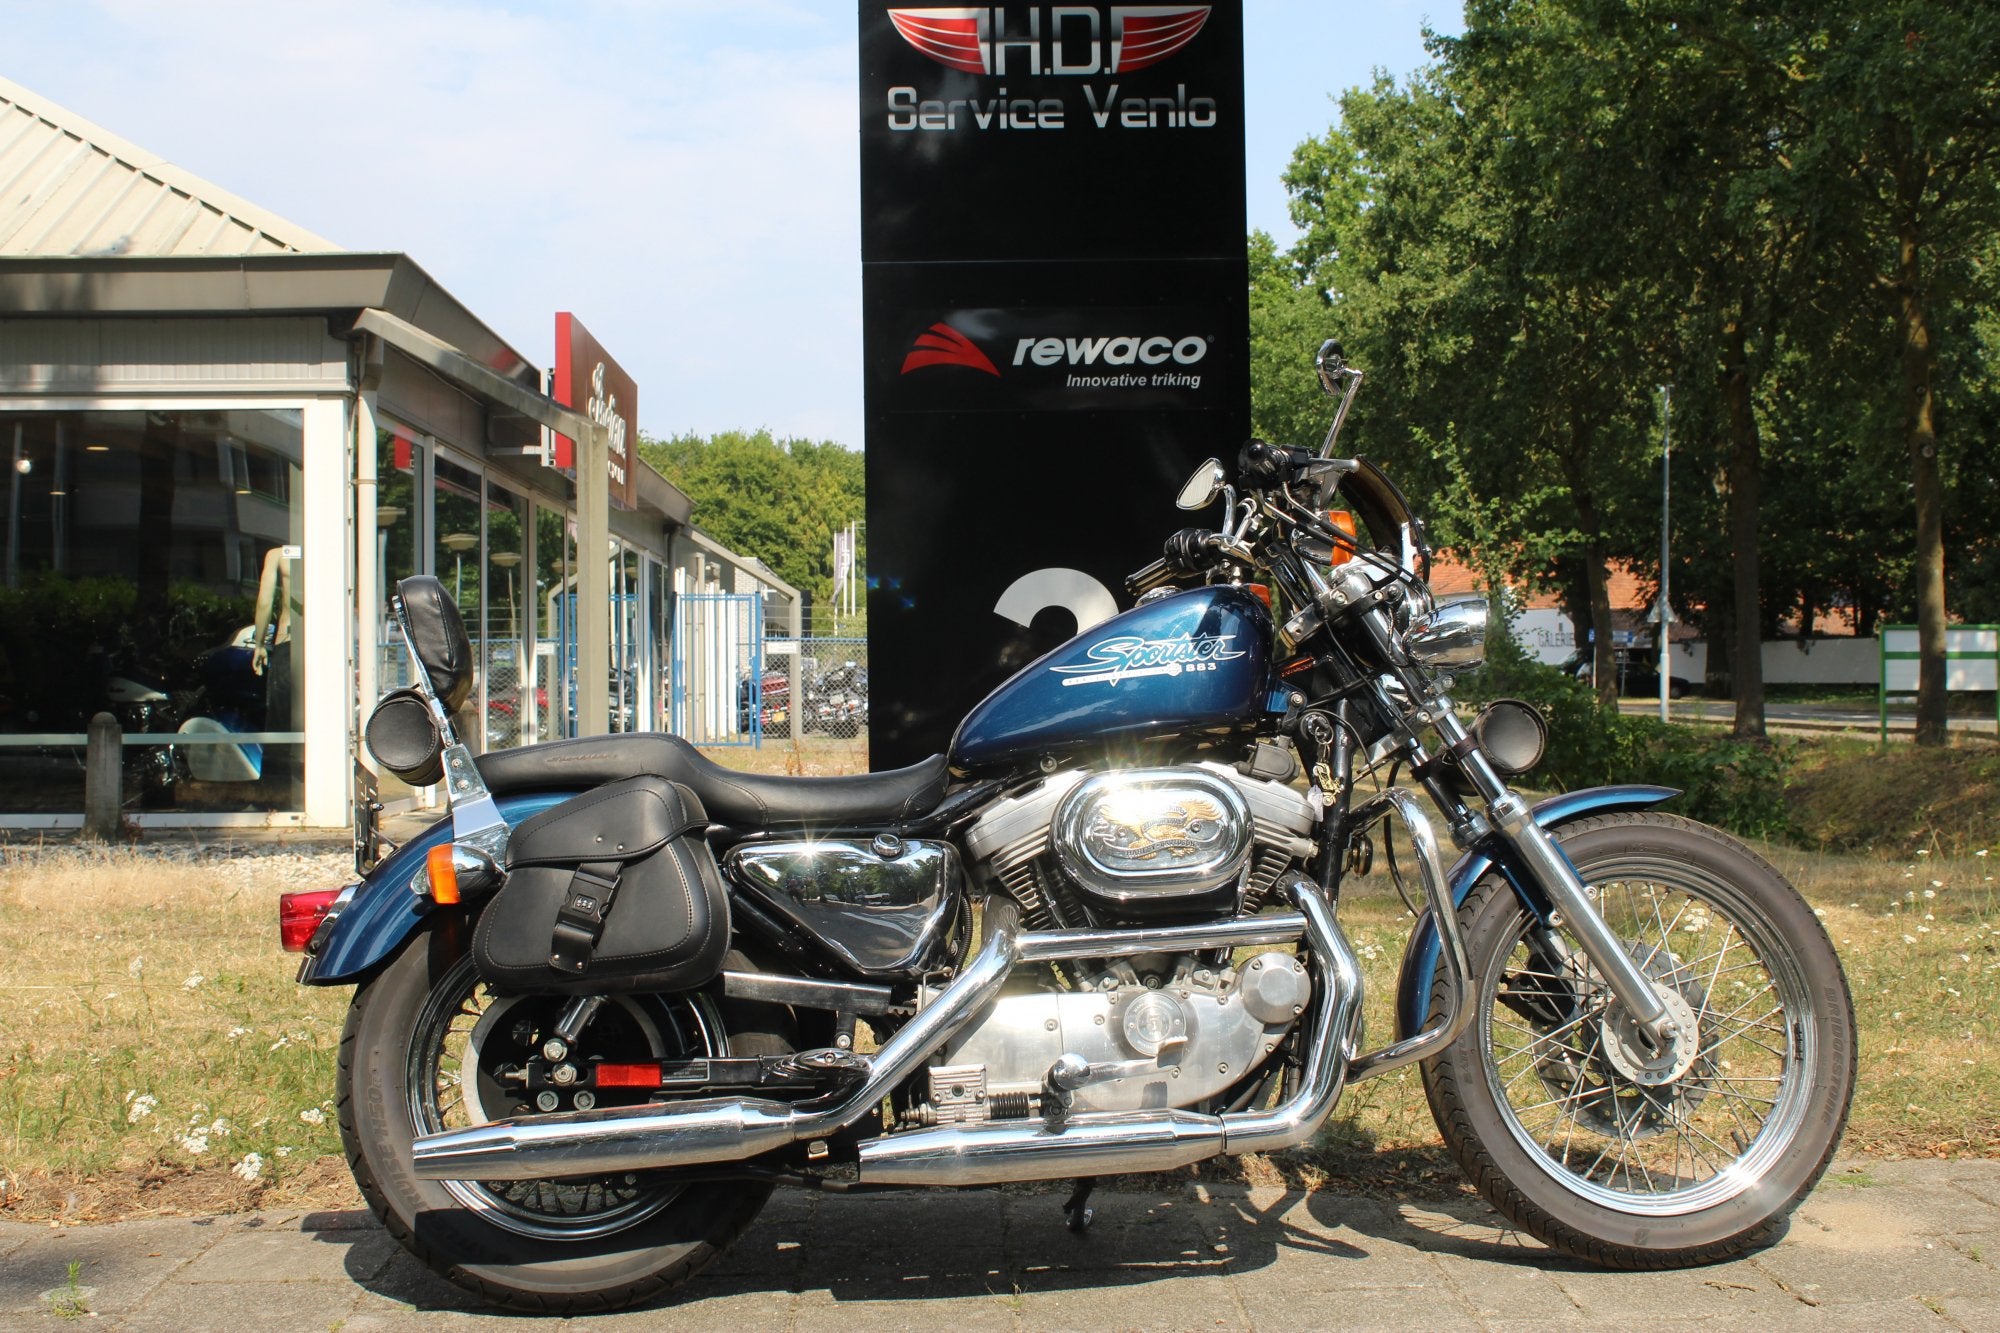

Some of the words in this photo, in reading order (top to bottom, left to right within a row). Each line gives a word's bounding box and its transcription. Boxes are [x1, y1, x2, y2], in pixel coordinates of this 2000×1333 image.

[887, 86, 1065, 131] Service
[1082, 83, 1217, 129] Venlo
[1012, 335, 1208, 367] rewaco
[1066, 373, 1147, 388] Innovative
[1151, 373, 1202, 389] triking
[1049, 632, 1247, 687] Sportster
[1185, 661, 1217, 673] 883
[1820, 986, 1844, 1126] BRIDGESTONE
